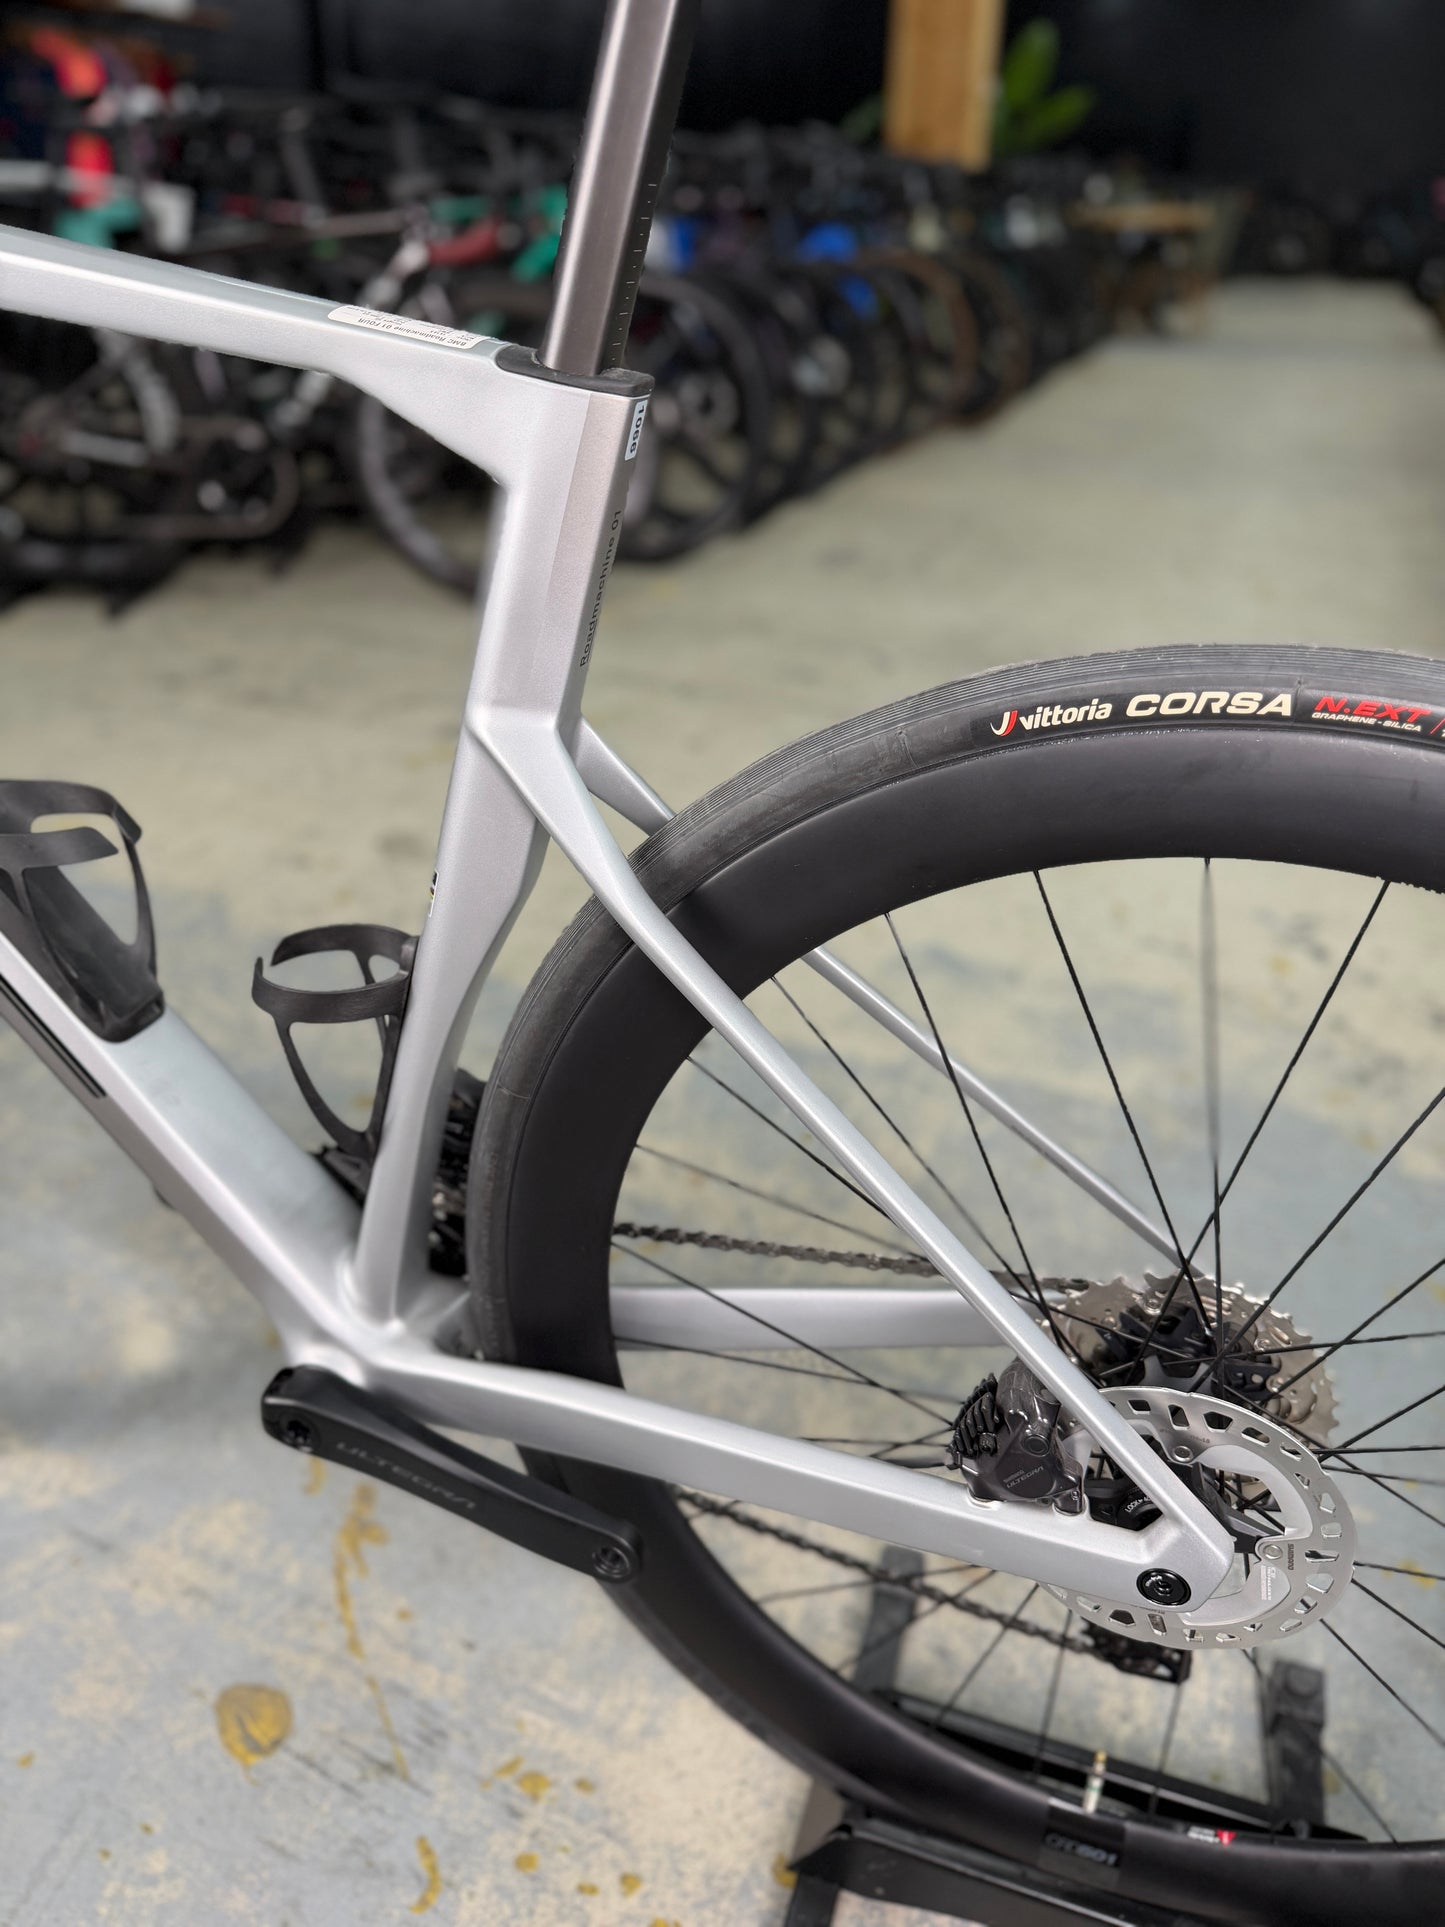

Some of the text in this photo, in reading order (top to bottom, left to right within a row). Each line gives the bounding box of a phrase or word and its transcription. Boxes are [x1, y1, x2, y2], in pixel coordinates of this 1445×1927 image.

[358, 318, 381, 328] FOUR
[381, 322, 391, 330] 01
[394, 326, 446, 343] Roadmachine
[447, 338, 467, 347] BMC
[580, 510, 621, 668] Roadmachine 01
[1020, 692, 1432, 731] vittoria CORSA N.EXT
[1312, 712, 1377, 725] GRAPHENE
[1383, 720, 1423, 732] SILICA
[337, 1441, 476, 1510] ULTEGRA
[1007, 1466, 1044, 1488] ULTEGRA
[1287, 1543, 1295, 1571] SHIMANO
